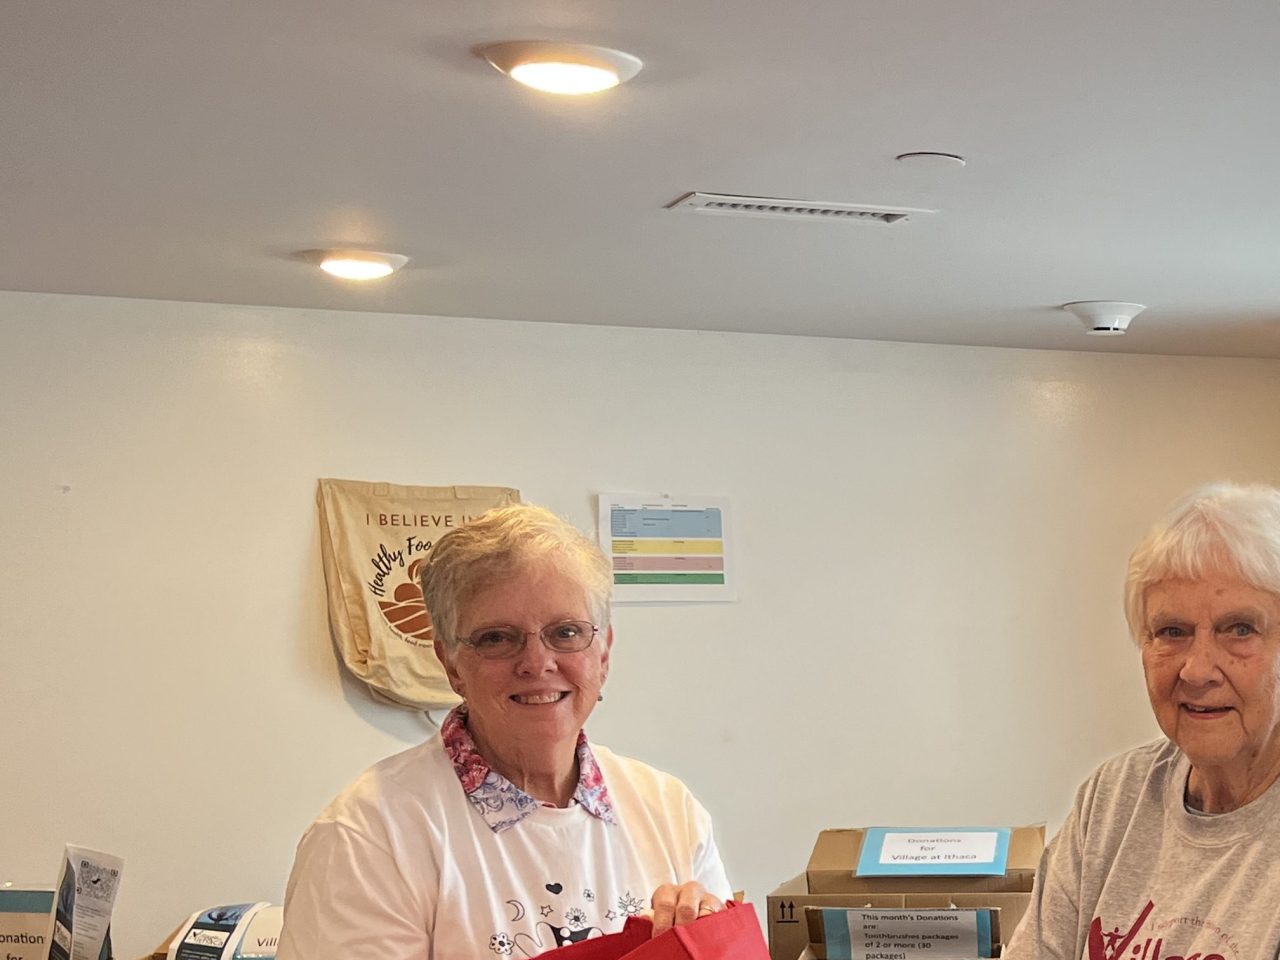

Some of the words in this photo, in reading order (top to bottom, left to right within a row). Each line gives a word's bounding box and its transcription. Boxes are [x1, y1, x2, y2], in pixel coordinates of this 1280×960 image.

[365, 512, 371, 526] I
[379, 513, 454, 527] BELIEVE
[368, 543, 405, 597] Healthy
[406, 535, 432, 556] Foo
[891, 854, 928, 862] Village
[861, 913, 879, 921] This
[0, 932, 46, 945] onation
[921, 933, 959, 941] packages
[256, 937, 279, 947] Vill
[865, 952, 906, 960] packages)
